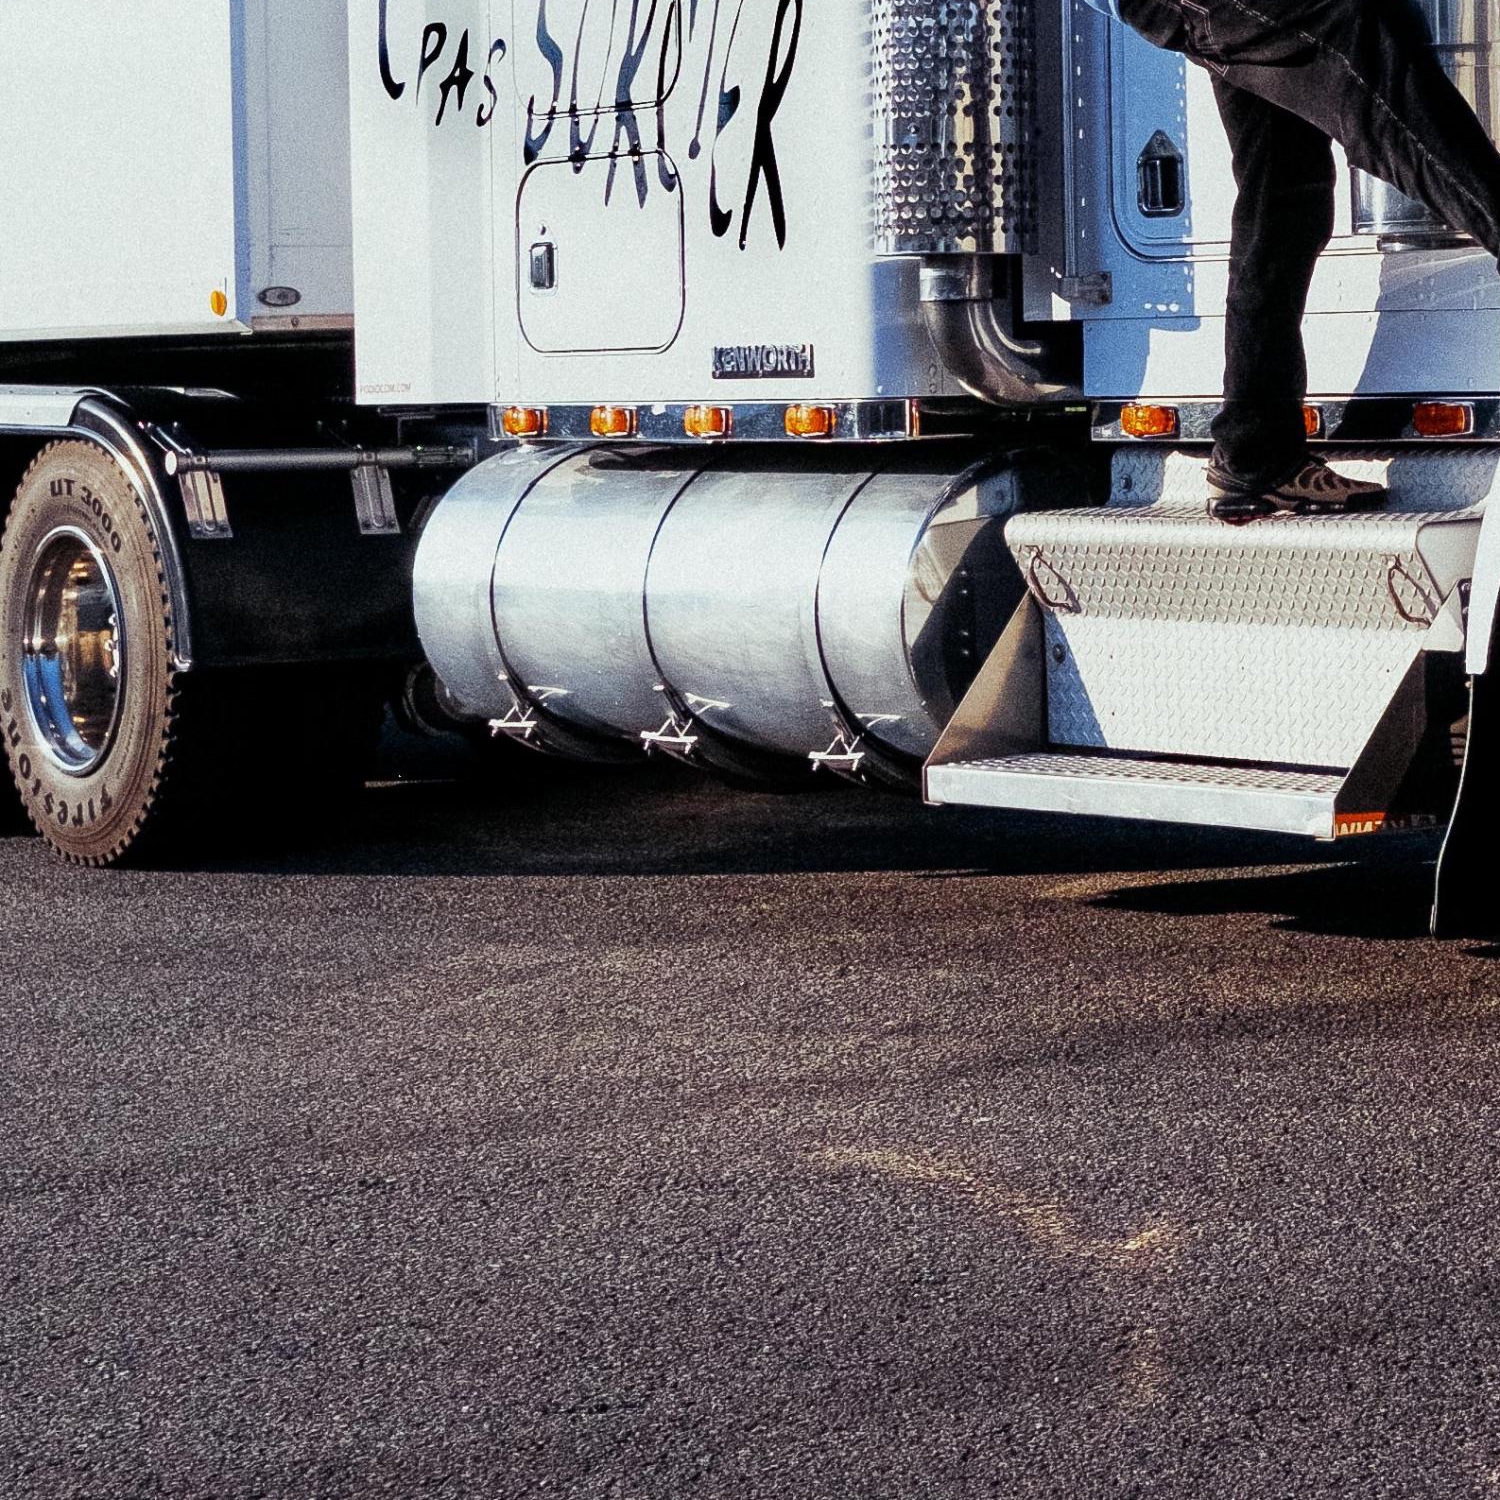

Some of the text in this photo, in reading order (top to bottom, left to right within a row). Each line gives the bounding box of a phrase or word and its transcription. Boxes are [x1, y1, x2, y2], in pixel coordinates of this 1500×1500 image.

[416, 21, 507, 127] PAS
[712, 344, 814, 374] KENWORTH
[50, 477, 76, 497] UT
[81, 484, 122, 553] 3000
